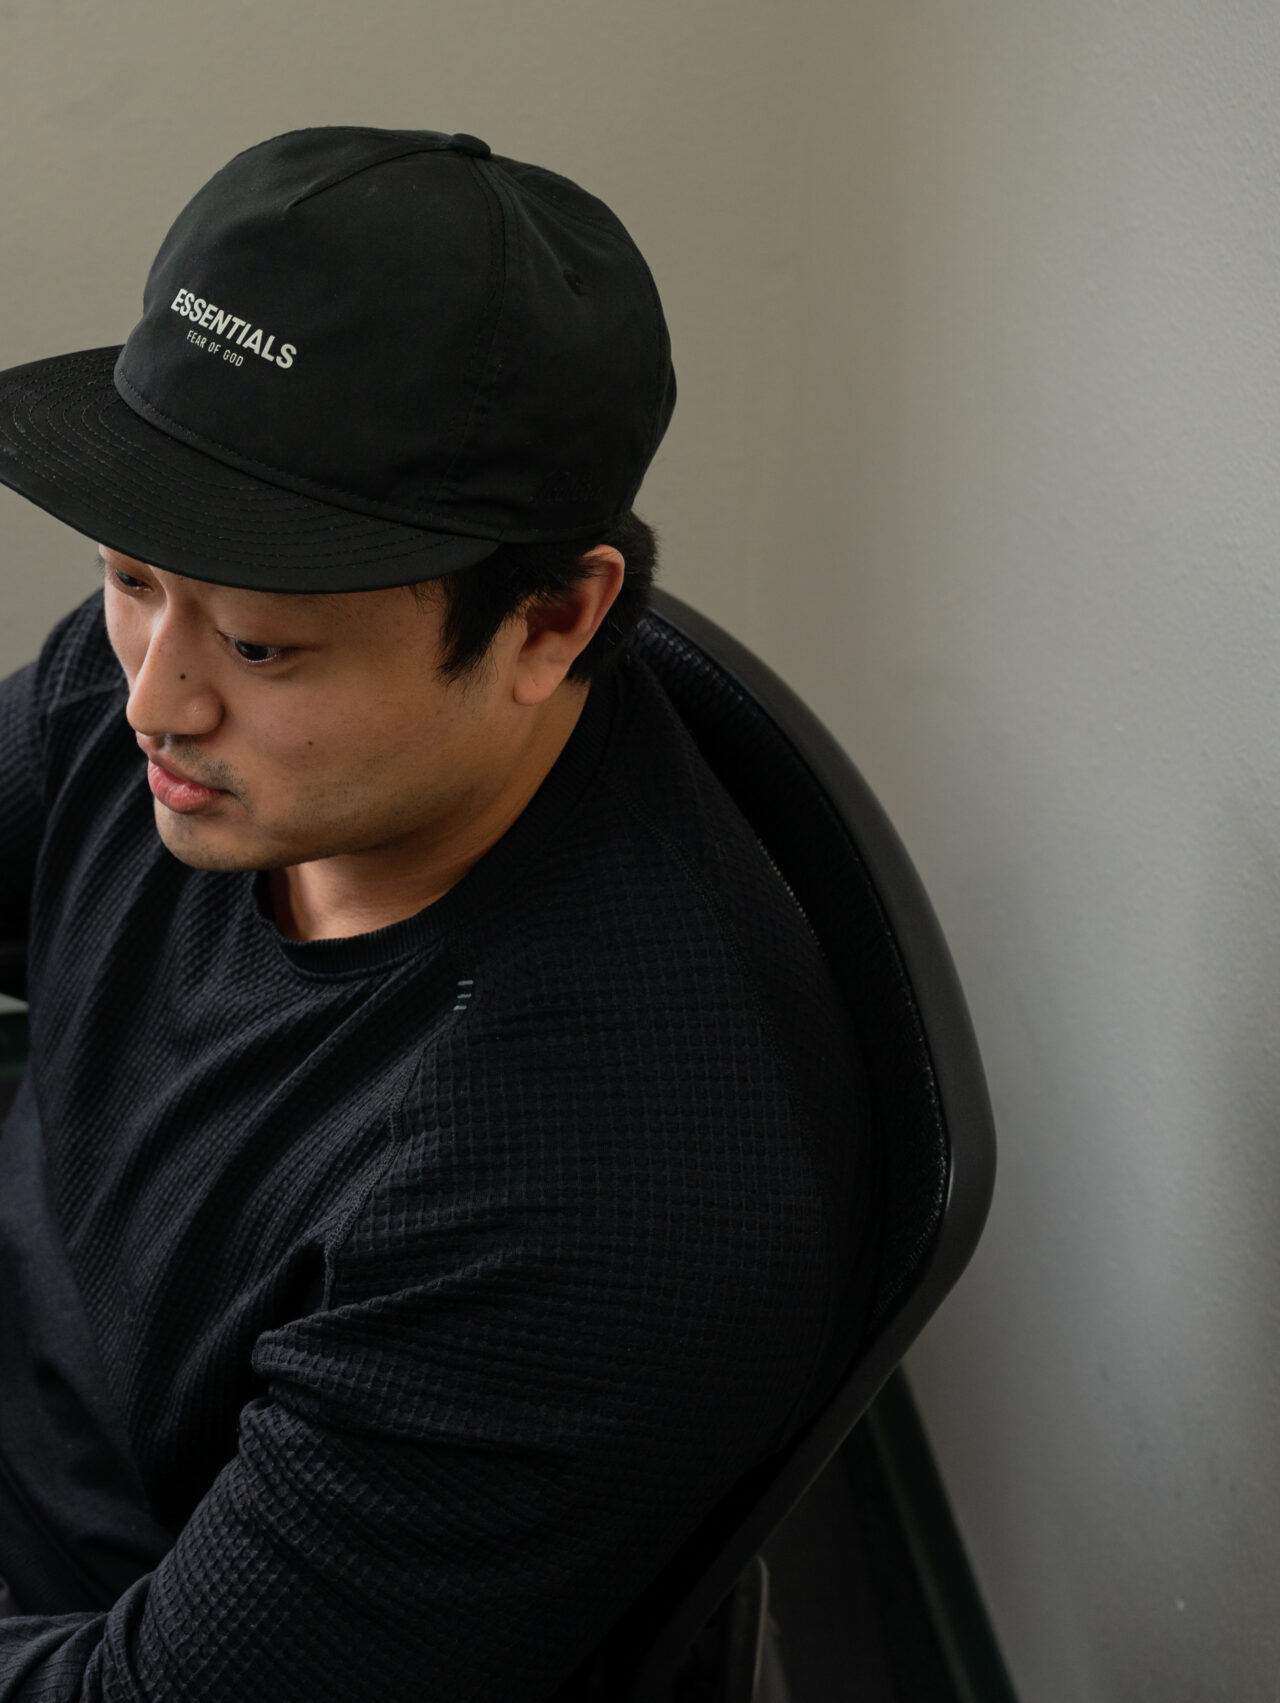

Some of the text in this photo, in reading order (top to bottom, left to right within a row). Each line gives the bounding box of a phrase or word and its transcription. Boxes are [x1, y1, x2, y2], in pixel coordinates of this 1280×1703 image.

[170, 288, 297, 369] ESSENTIALS
[186, 330, 244, 367] FEAR OF GOD
